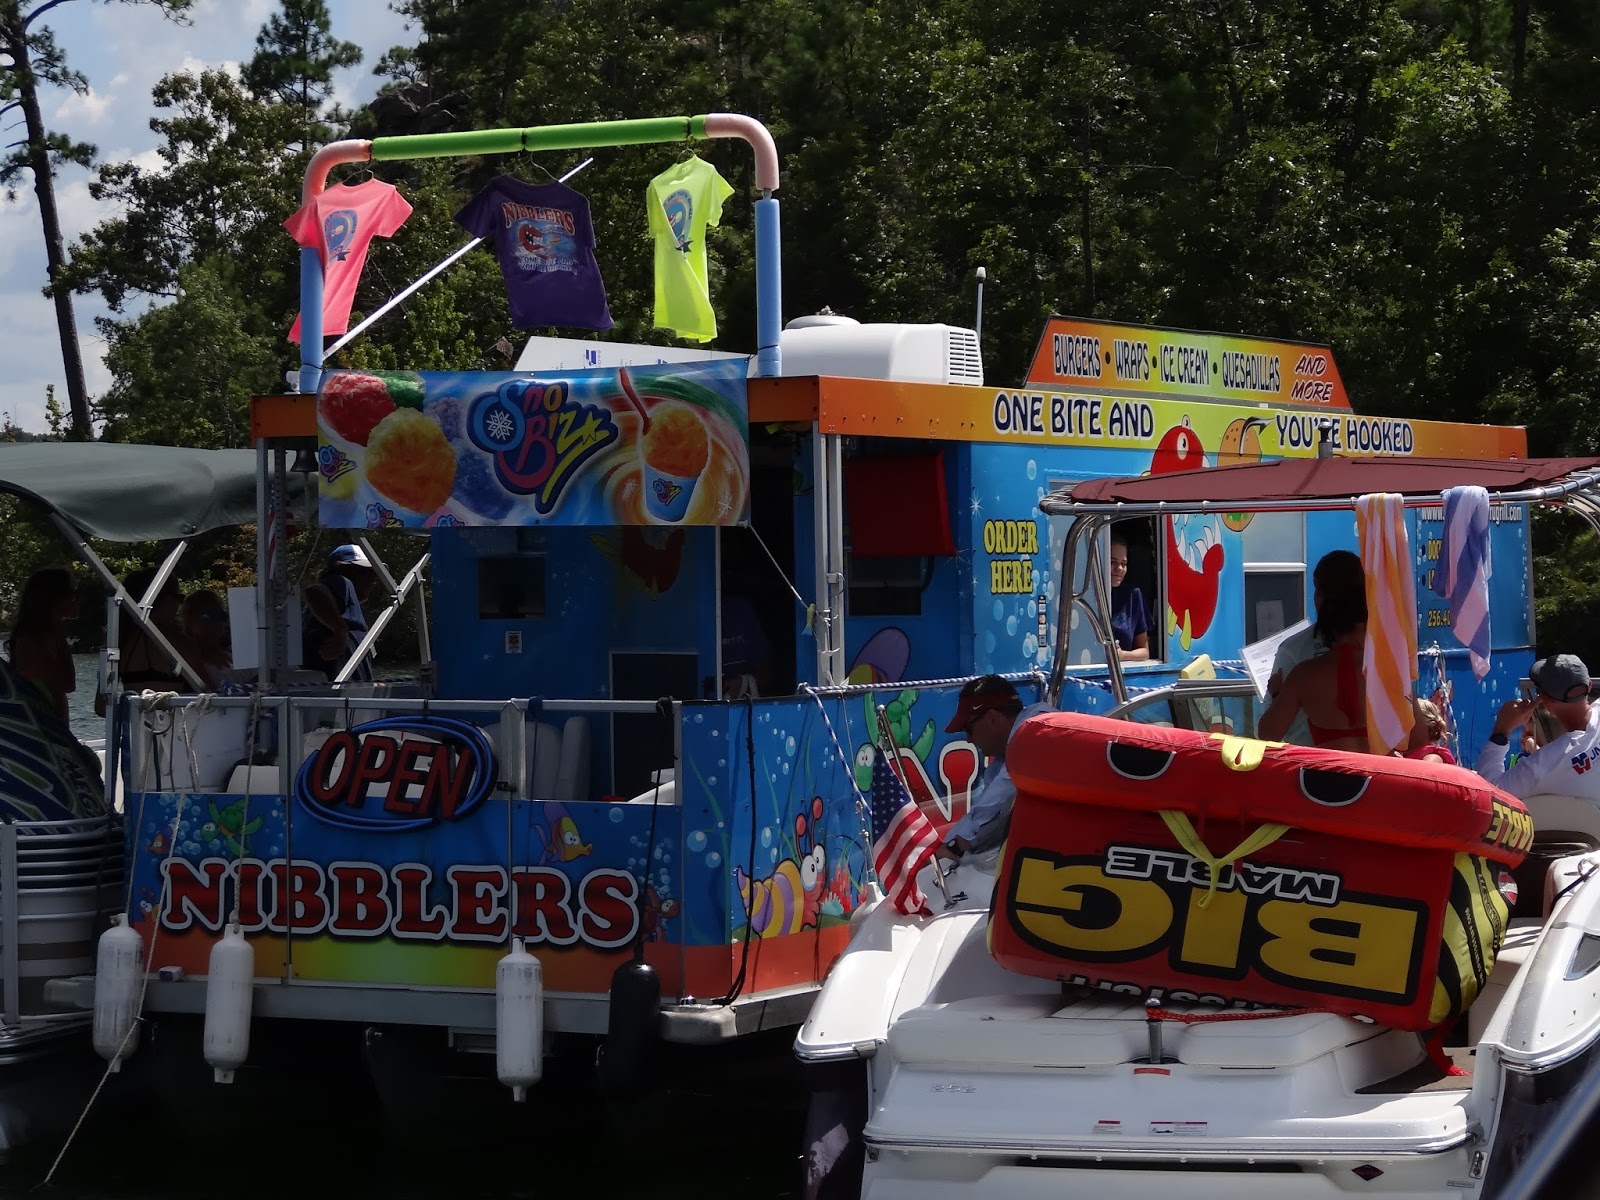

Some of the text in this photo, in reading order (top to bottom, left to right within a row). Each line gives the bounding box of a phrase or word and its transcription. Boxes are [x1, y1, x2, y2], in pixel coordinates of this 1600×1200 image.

[501, 202, 576, 236] NIBBLERS
[1054, 334, 1280, 393] BURGERS WRAPS ICE CREAM QUESADILLAS
[1295, 354, 1326, 376] AND
[1291, 380, 1333, 402] MORE
[994, 393, 1044, 433] ONE
[1051, 397, 1102, 436] BITE
[1109, 401, 1154, 438] AND
[1347, 418, 1413, 454] HOOKED
[983, 519, 1039, 555] ORDER
[990, 559, 1034, 595] HERE
[313, 731, 474, 819] OPEN
[1485, 802, 1535, 853] ABLE
[1104, 846, 1340, 904] MABLE
[162, 858, 641, 947] NIBBLERS
[1012, 857, 1420, 997] BIG
